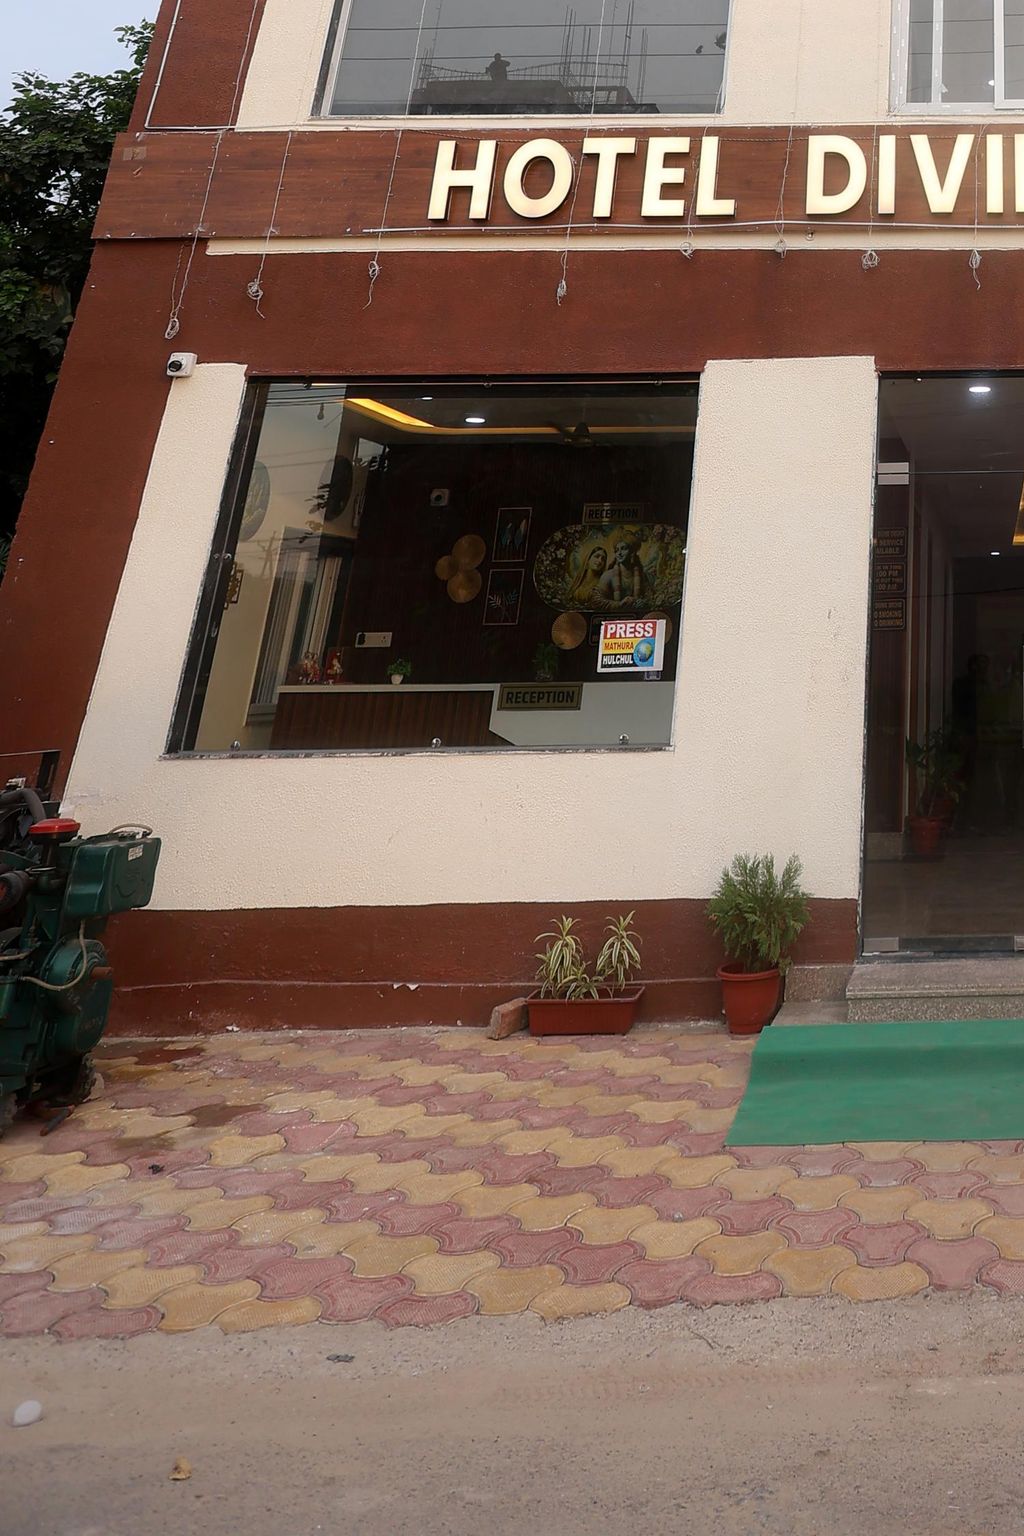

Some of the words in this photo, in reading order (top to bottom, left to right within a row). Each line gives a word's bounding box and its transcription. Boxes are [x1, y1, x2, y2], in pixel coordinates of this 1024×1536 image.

[427, 135, 737, 220] HOTEL
[588, 508, 639, 520] RECEPTION
[606, 622, 654, 639] PRESS
[604, 642, 634, 651] MATHURA
[602, 654, 634, 665] HULCHUL
[506, 690, 575, 704] RECEPTION
